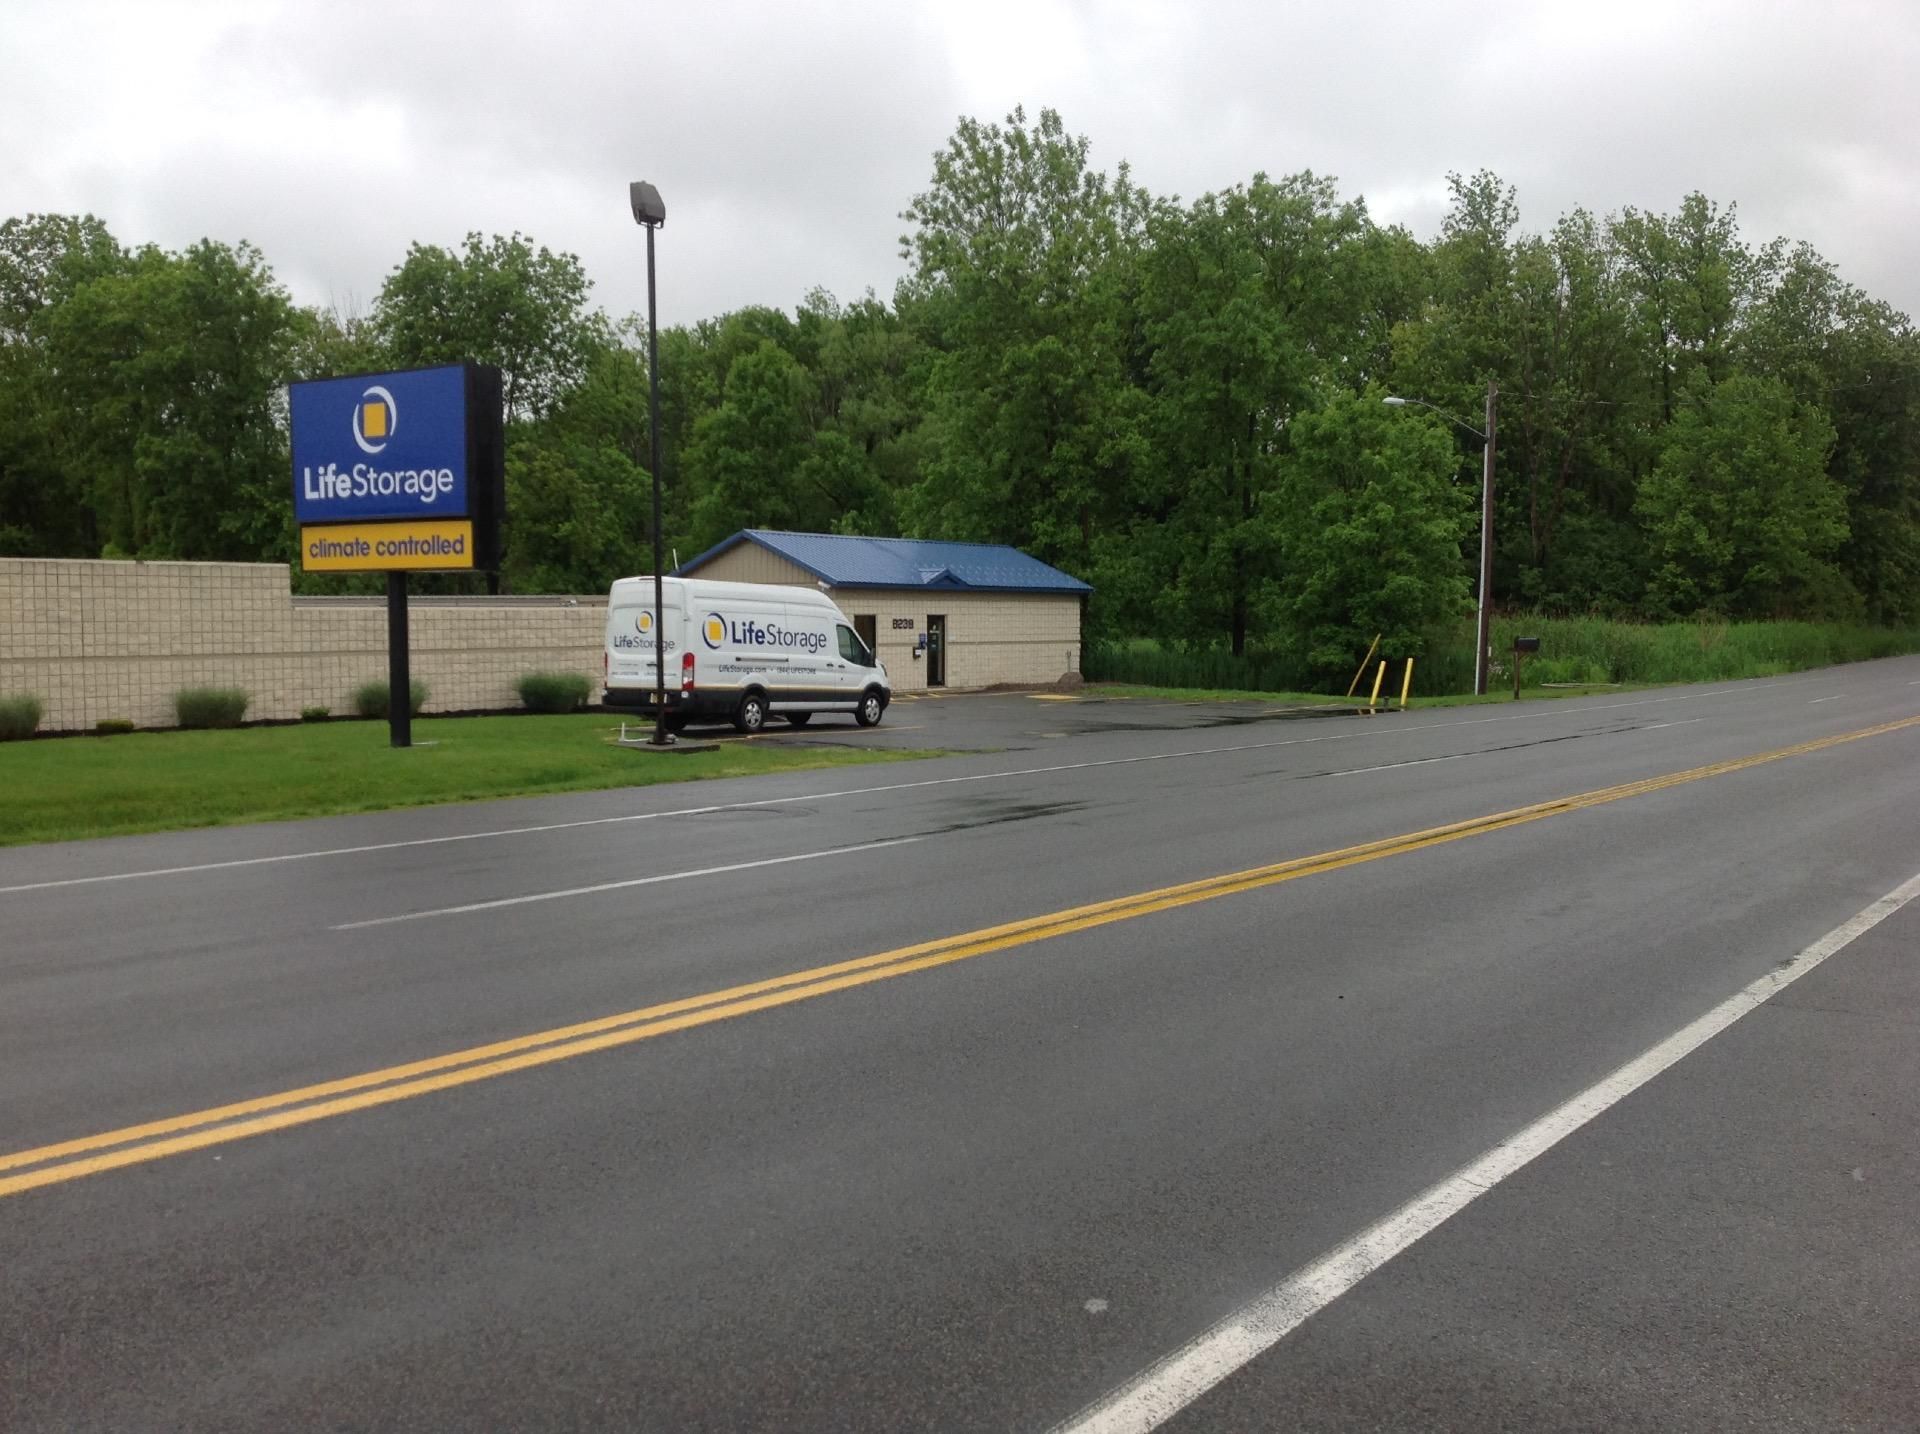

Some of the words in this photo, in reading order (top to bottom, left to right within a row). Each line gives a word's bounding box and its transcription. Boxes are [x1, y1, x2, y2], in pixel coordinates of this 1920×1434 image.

[303, 463, 454, 503] LifeStorage
[309, 537, 371, 559] climate
[375, 534, 465, 556] controlled
[613, 635, 676, 652] LifeStorge
[731, 620, 827, 654] LifeStorage
